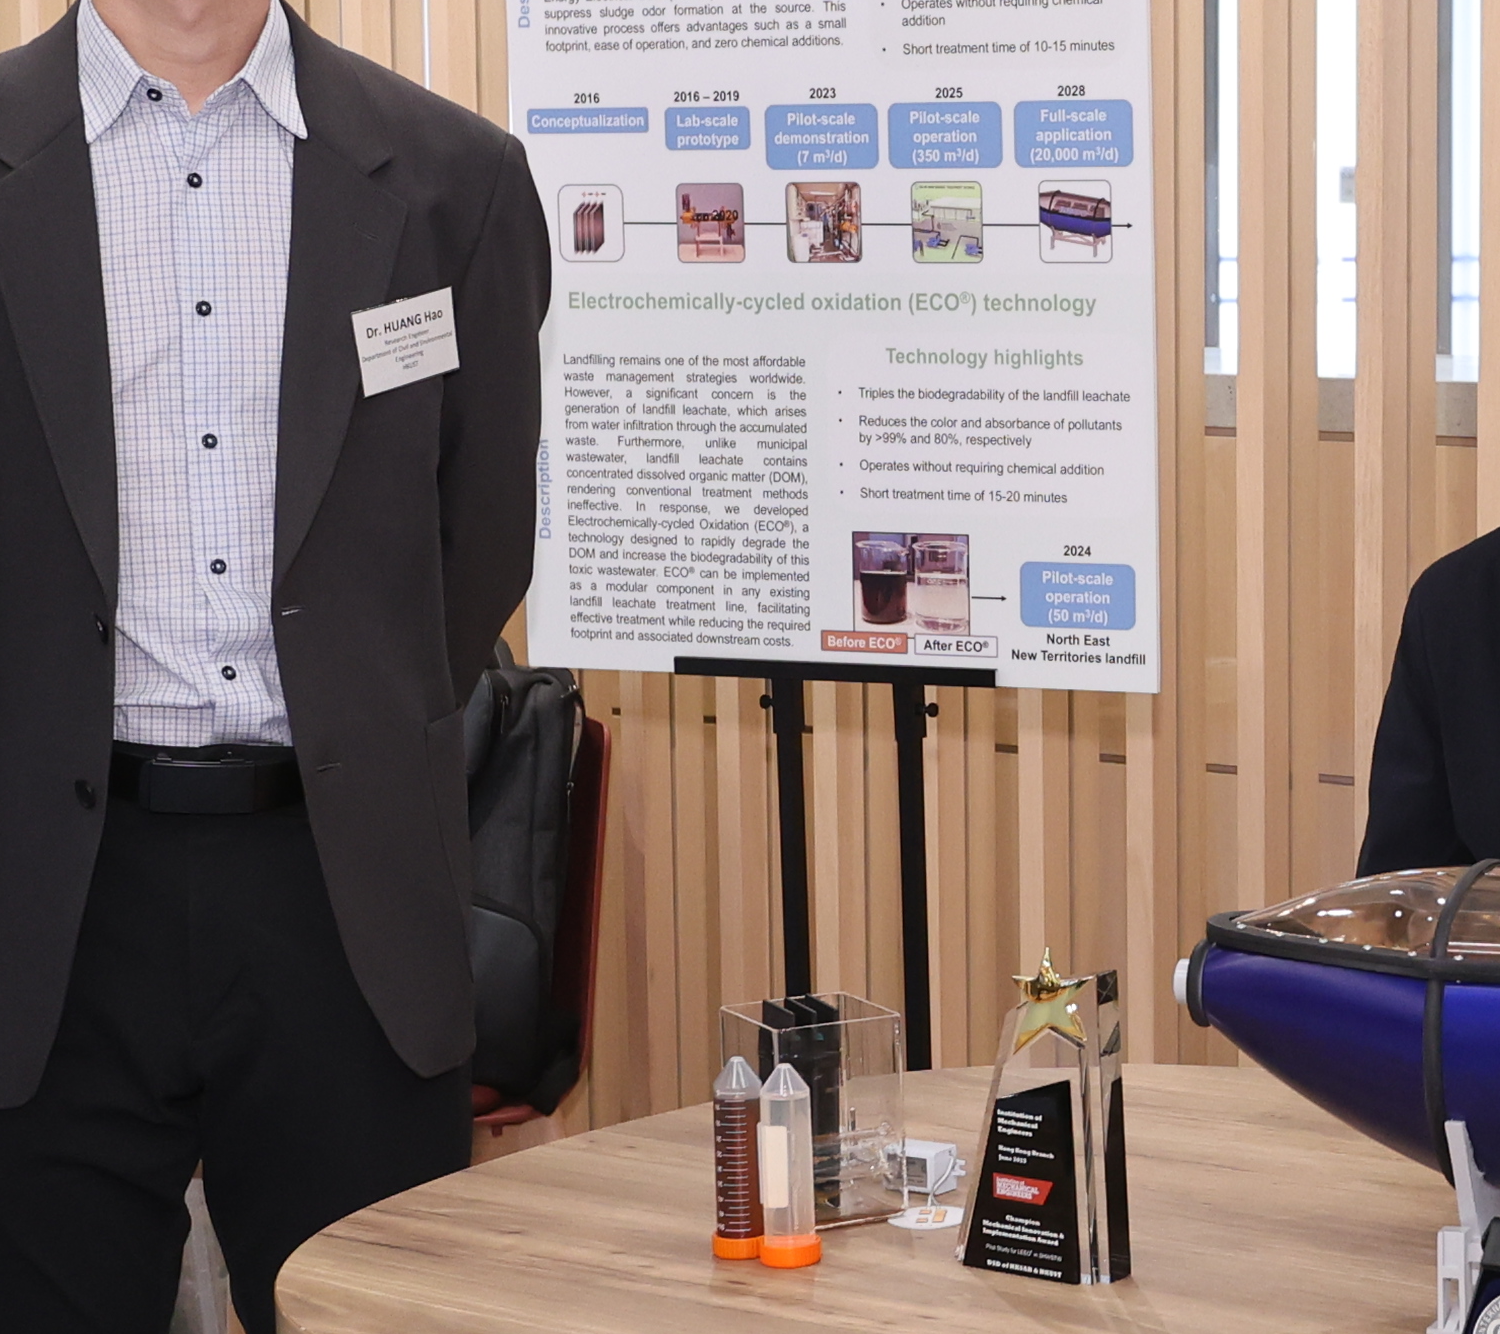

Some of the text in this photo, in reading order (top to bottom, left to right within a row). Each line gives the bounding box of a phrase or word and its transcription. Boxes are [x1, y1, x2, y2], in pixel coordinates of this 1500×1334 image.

[902, 40, 1114, 55] Short treatment time of 10-15 minutes
[574, 93, 600, 104] 2016
[674, 91, 700, 103] 2016
[713, 91, 739, 102] 2019
[810, 87, 836, 99] 2023
[935, 87, 962, 98] 2025
[1057, 85, 1085, 97] 2028
[532, 115, 644, 130] Conceptualization
[676, 113, 738, 128] Lab-scale
[788, 112, 855, 126] Pilot-scale
[910, 110, 980, 124] Pilot-scale
[1040, 109, 1106, 123] Full-scale
[676, 133, 739, 148] prototype
[774, 131, 869, 145] demonstration
[913, 130, 976, 145] operation
[1036, 128, 1112, 143] application
[798, 150, 847, 165] (7 m³/d)
[912, 148, 979, 165] (350 m³/d)
[1030, 147, 1119, 163] (20,000 m³/d)
[568, 291, 1096, 316] Electrochemically-cycled oxidation (ECO®) technology
[366, 309, 443, 339] Dr. HUANG Hao
[886, 347, 1083, 369] Technology highlights
[538, 439, 551, 539] Description
[1063, 546, 1091, 557] 2024
[1042, 571, 1113, 587] Pilot-scale
[1045, 592, 1110, 607] operation
[1048, 608, 1108, 626] (50 m³/d)
[827, 635, 901, 650] Before ECO®
[924, 640, 989, 653] After ECO®
[1047, 634, 1110, 647] North East
[1011, 649, 1145, 665] New Territories landfill
[1006, 1214, 1040, 1226] Champion
